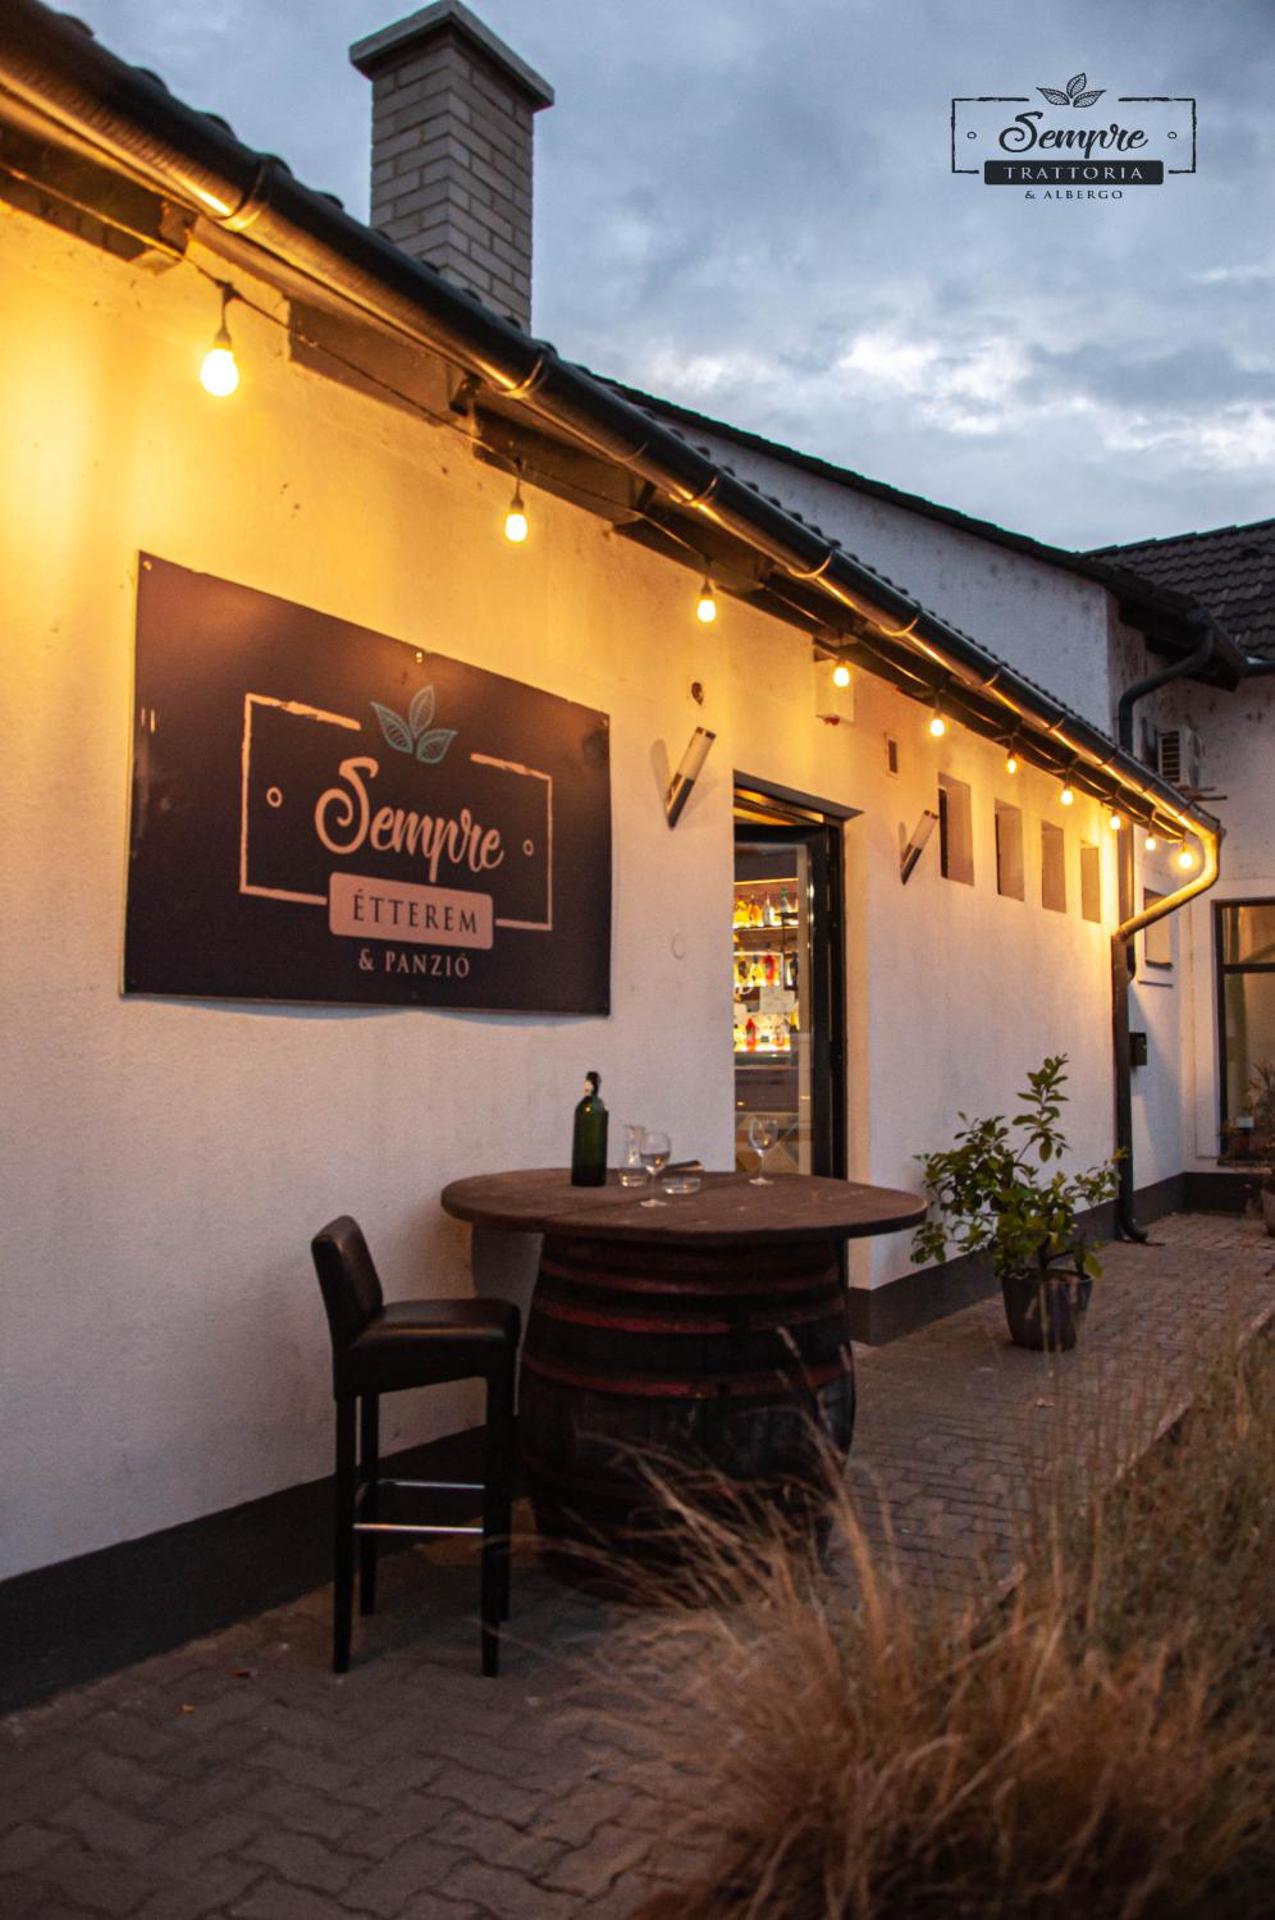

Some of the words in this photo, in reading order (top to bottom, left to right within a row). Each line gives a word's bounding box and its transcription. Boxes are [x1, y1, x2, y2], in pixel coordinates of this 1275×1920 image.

[314, 756, 504, 883] Sempre
[352, 888, 477, 934] ÉTTEREM
[358, 949, 374, 971] &
[385, 951, 470, 978] PANZIÓ
